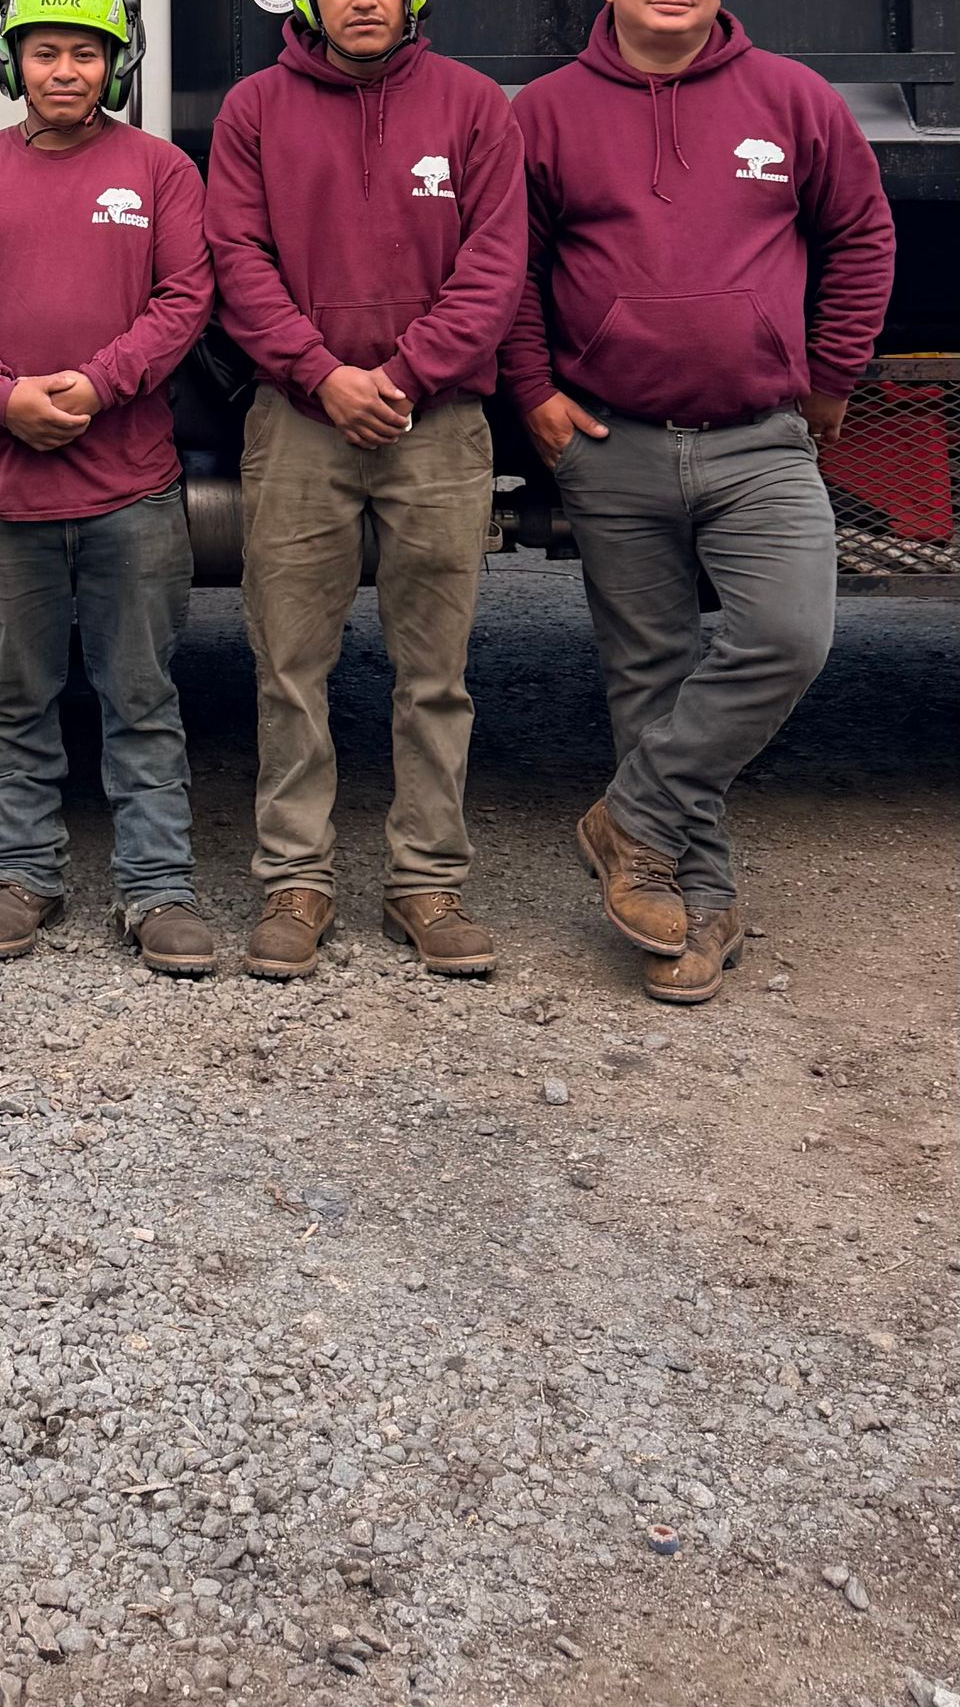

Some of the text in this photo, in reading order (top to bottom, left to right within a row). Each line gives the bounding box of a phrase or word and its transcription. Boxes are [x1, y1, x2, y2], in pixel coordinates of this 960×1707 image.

[735, 168, 755, 179] ALL
[411, 187, 430, 197] ALL
[91, 211, 150, 229] ALL ACCESS
